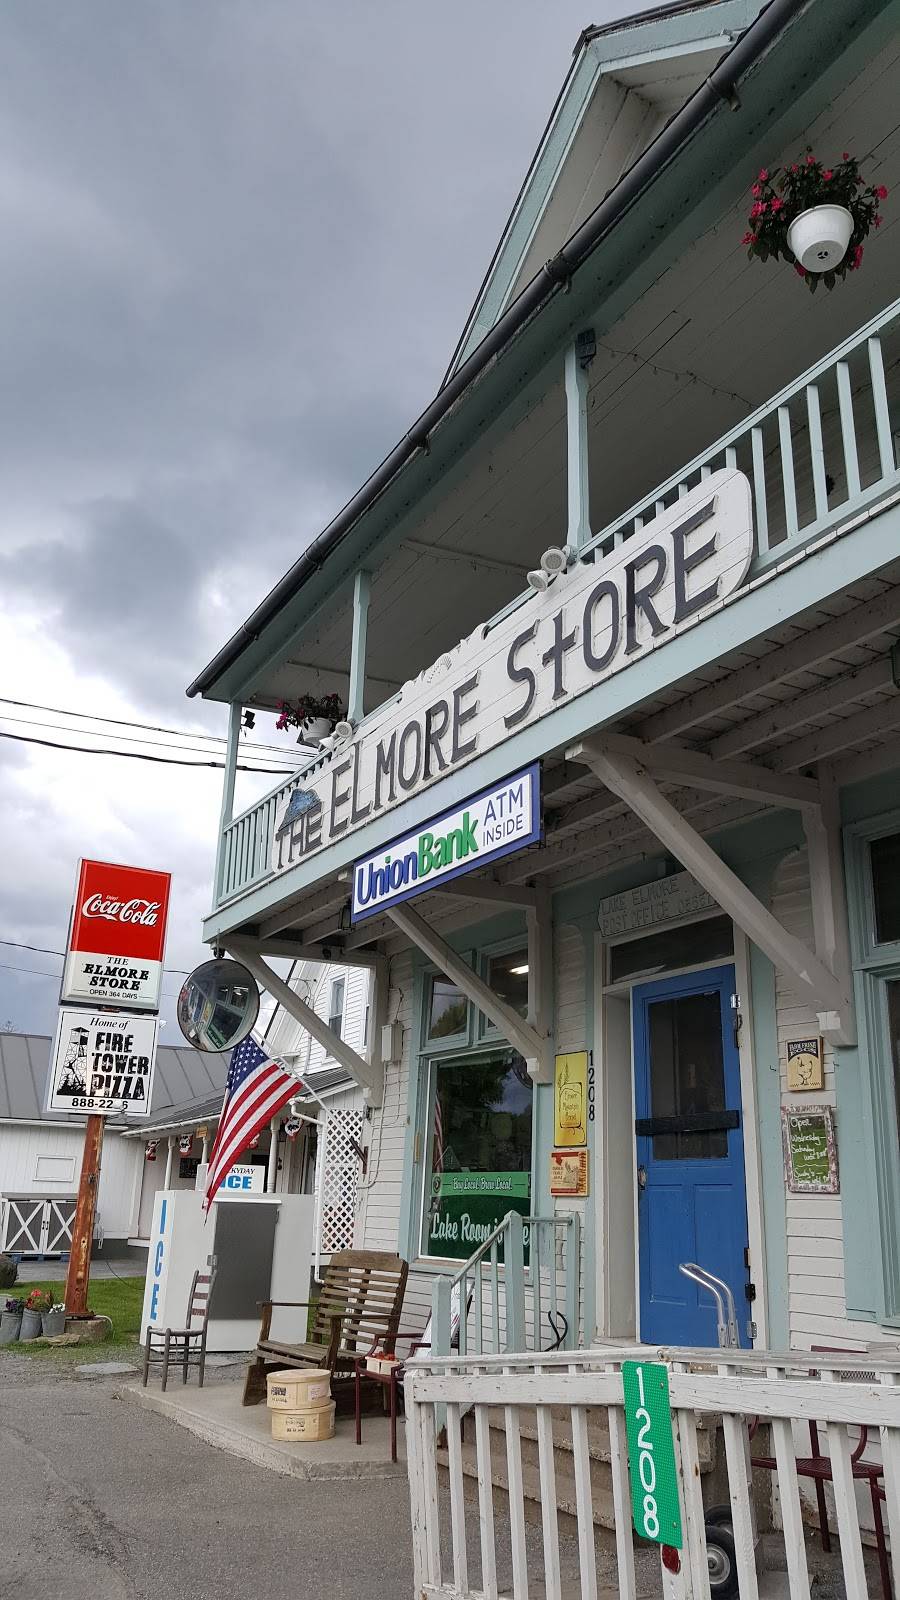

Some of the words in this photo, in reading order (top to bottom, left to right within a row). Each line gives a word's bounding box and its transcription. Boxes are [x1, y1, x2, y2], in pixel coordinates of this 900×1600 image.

[275, 804, 322, 869] THE
[328, 669, 482, 838] ELMORE
[483, 783, 523, 826] ATM
[482, 813, 523, 847] INSIDE
[82, 893, 162, 926] Coca-Cola
[83, 963, 150, 981] ELMORE
[107, 956, 129, 966] THE
[89, 975, 141, 991] STORE
[89, 988, 108, 996] OPEN
[109, 990, 121, 998] 364
[121, 992, 138, 1000] DAYS
[90, 1017, 118, 1028] Home
[119, 1020, 131, 1030] of
[95, 1032, 134, 1053] FIRE
[91, 1052, 150, 1076] TOWER
[89, 1073, 145, 1100] PIZZA
[72, 1097, 129, 1110] 888-226
[790, 1117, 812, 1131] Open
[453, 1177, 464, 1192] Buy
[430, 1212, 459, 1241] Lake
[460, 1212, 491, 1243] Room
[149, 1199, 168, 1321] ICE
[635, 1366, 660, 1539] 1208
